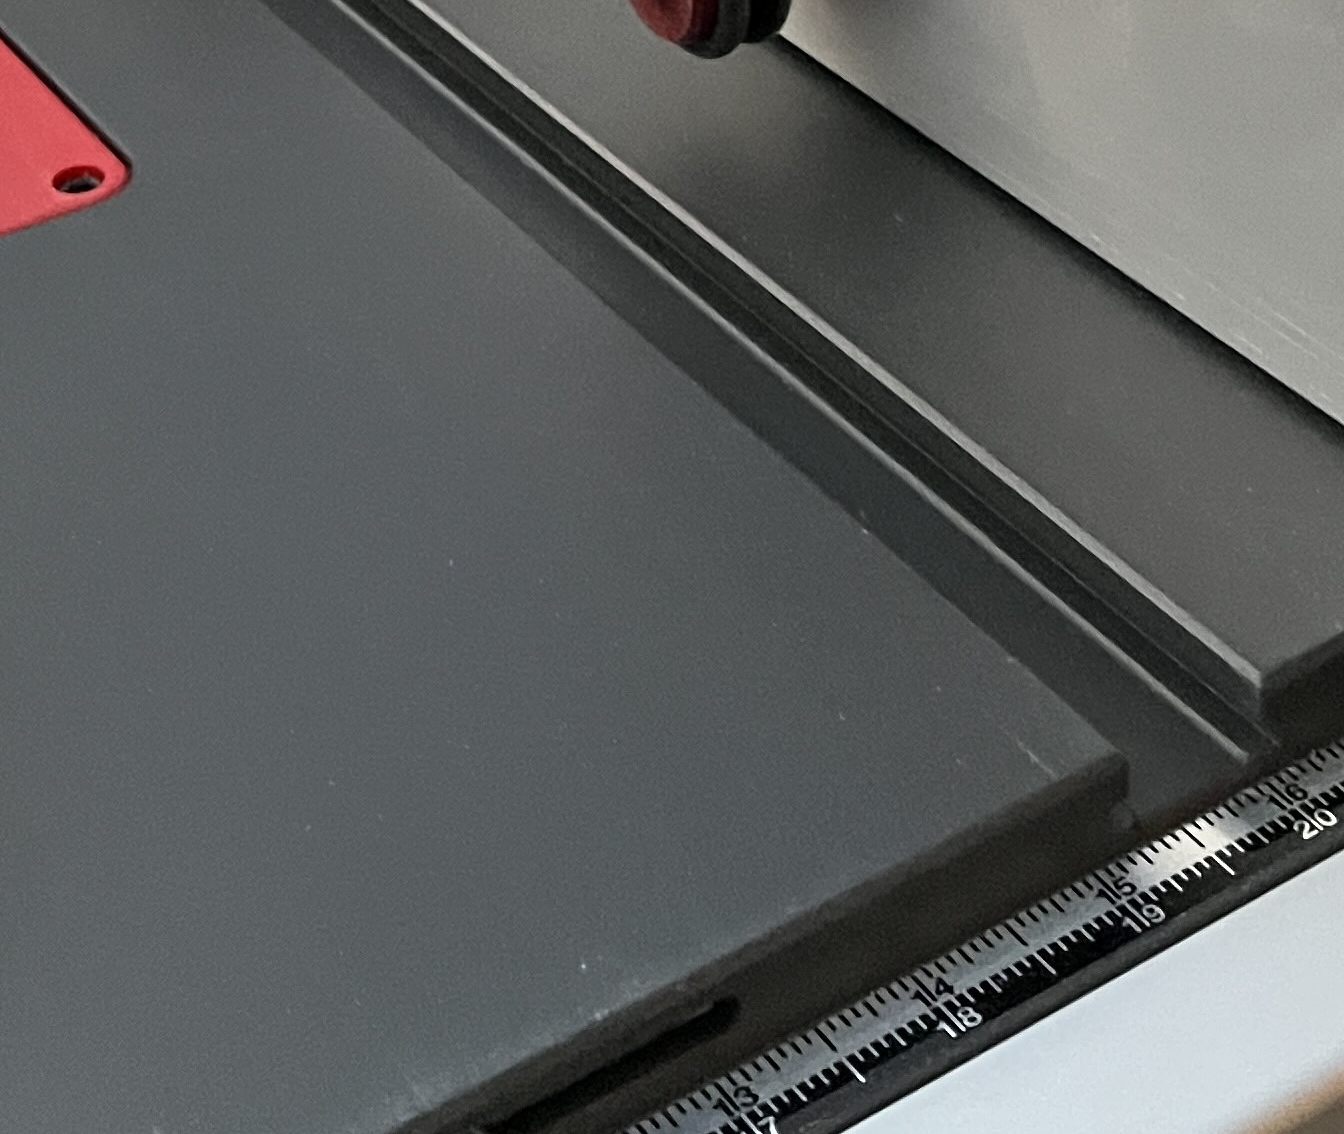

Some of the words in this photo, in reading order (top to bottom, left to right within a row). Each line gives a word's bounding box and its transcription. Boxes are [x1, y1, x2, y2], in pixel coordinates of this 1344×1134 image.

[1268, 784, 1308, 809] 16
[1293, 809, 1338, 840] 20
[1096, 876, 1136, 904] 15
[1122, 904, 1166, 933] 19
[911, 977, 954, 1007] 14
[936, 1006, 982, 1038] 18
[712, 1086, 759, 1116] 13
